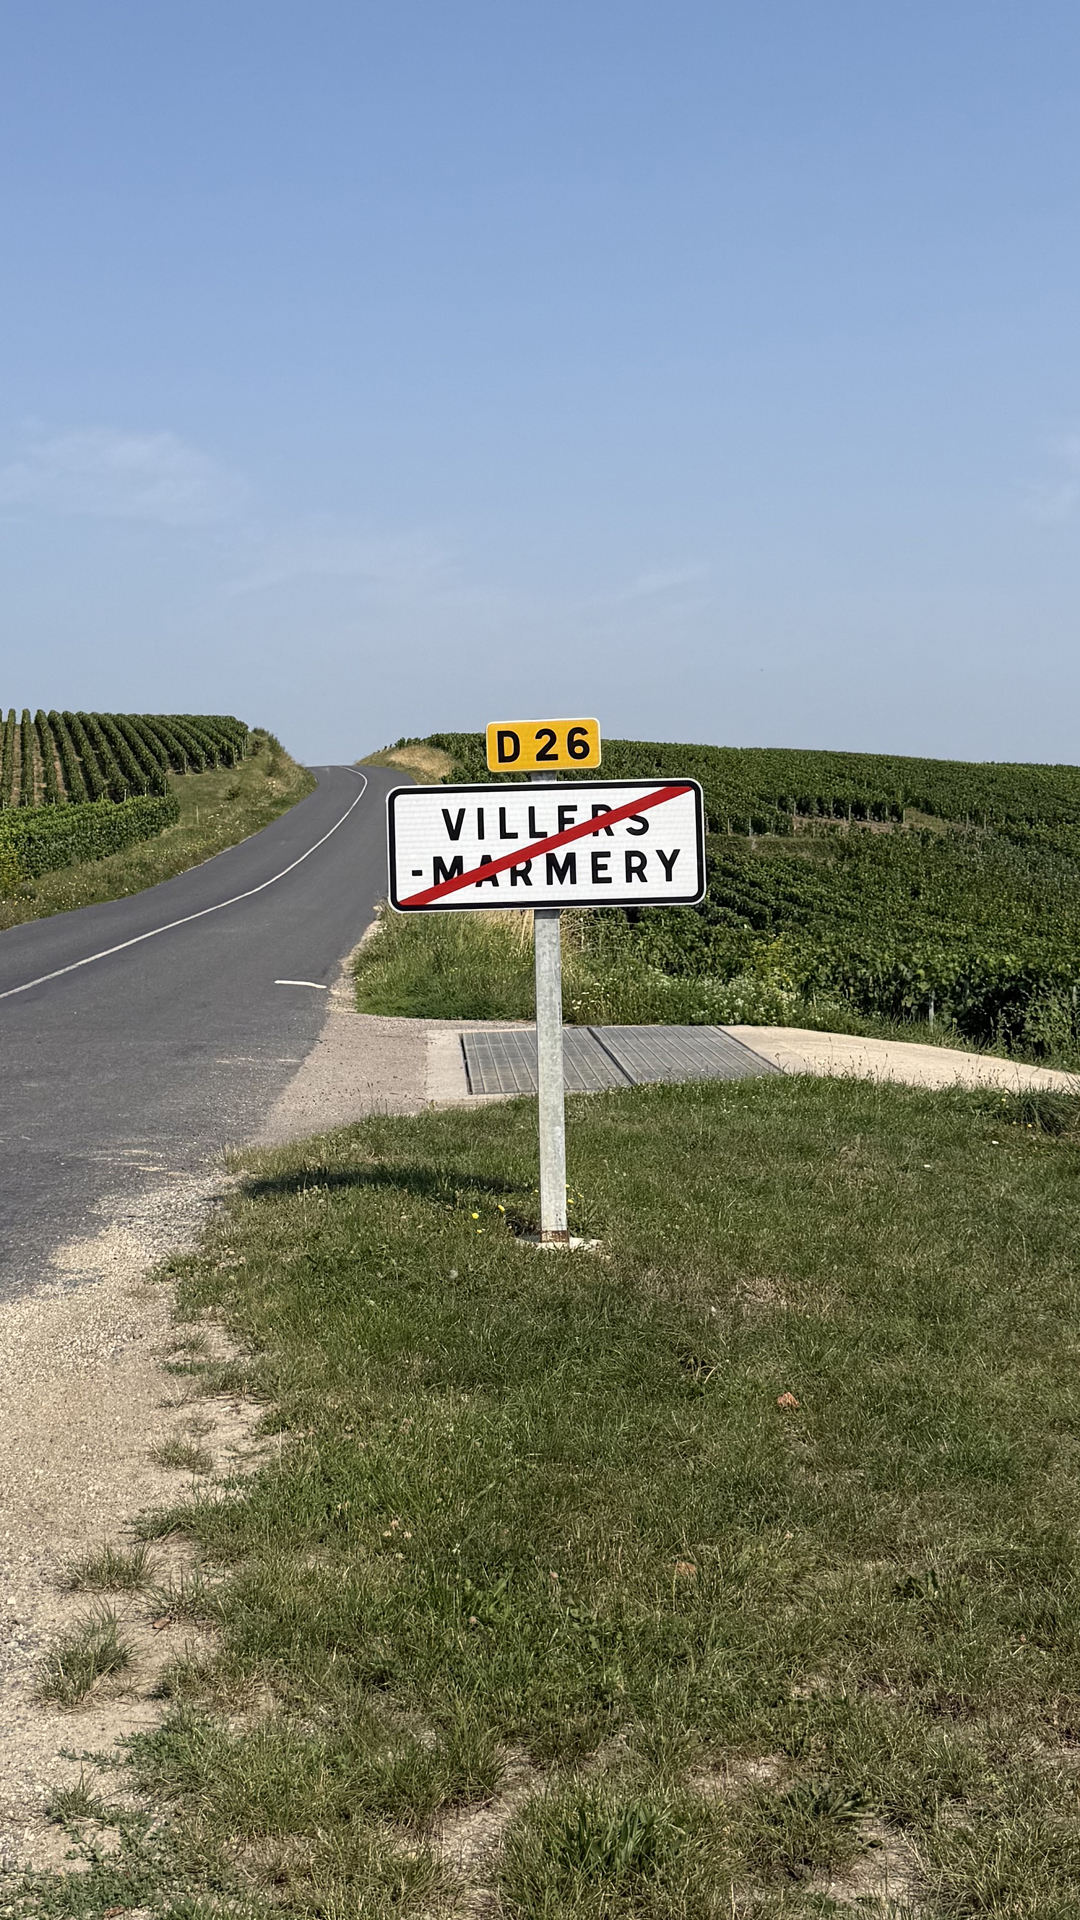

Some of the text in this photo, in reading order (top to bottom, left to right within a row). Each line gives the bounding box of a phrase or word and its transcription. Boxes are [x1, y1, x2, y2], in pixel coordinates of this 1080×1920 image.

[497, 726, 590, 763] D 26
[442, 804, 650, 840] VILLERS
[411, 849, 681, 887] -MARMERY
